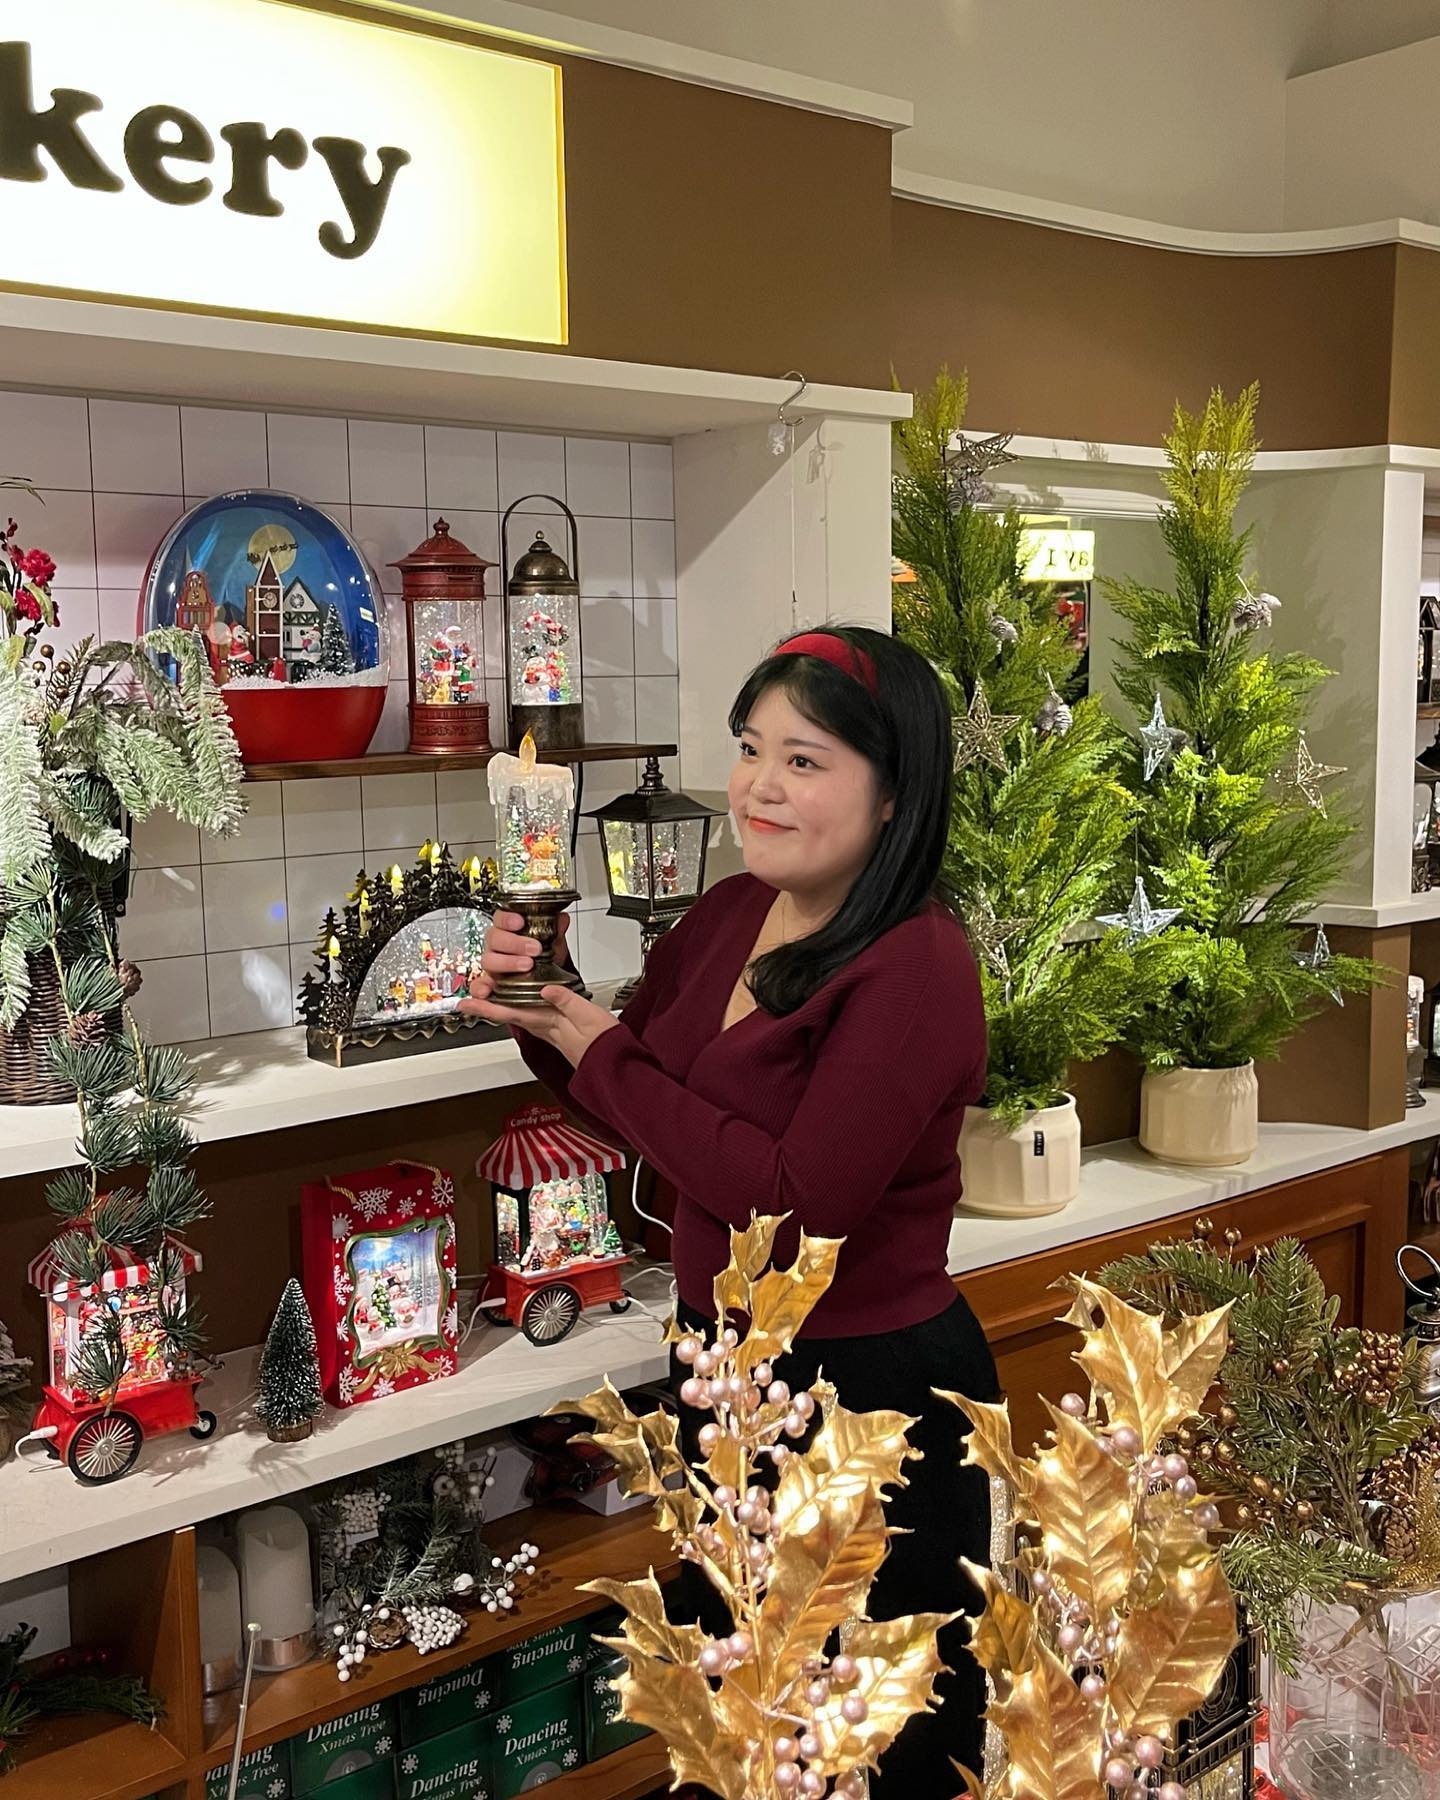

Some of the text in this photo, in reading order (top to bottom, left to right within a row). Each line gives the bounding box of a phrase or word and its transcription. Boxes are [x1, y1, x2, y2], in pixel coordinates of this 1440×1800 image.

[0, 40, 412, 260] kery
[511, 1116, 537, 1127] Candy
[511, 1633, 576, 1670] Dancing
[417, 1667, 484, 1706] Dancing
[306, 1703, 381, 1743] Dancing
[319, 1720, 386, 1755] Xmas Tree
[504, 1719, 569, 1757] Dancing
[515, 1735, 574, 1768] Xmas Tree
[251, 1763, 279, 1780] Tree
[410, 1759, 479, 1799] Dancing
[460, 1776, 483, 1793] Tree
